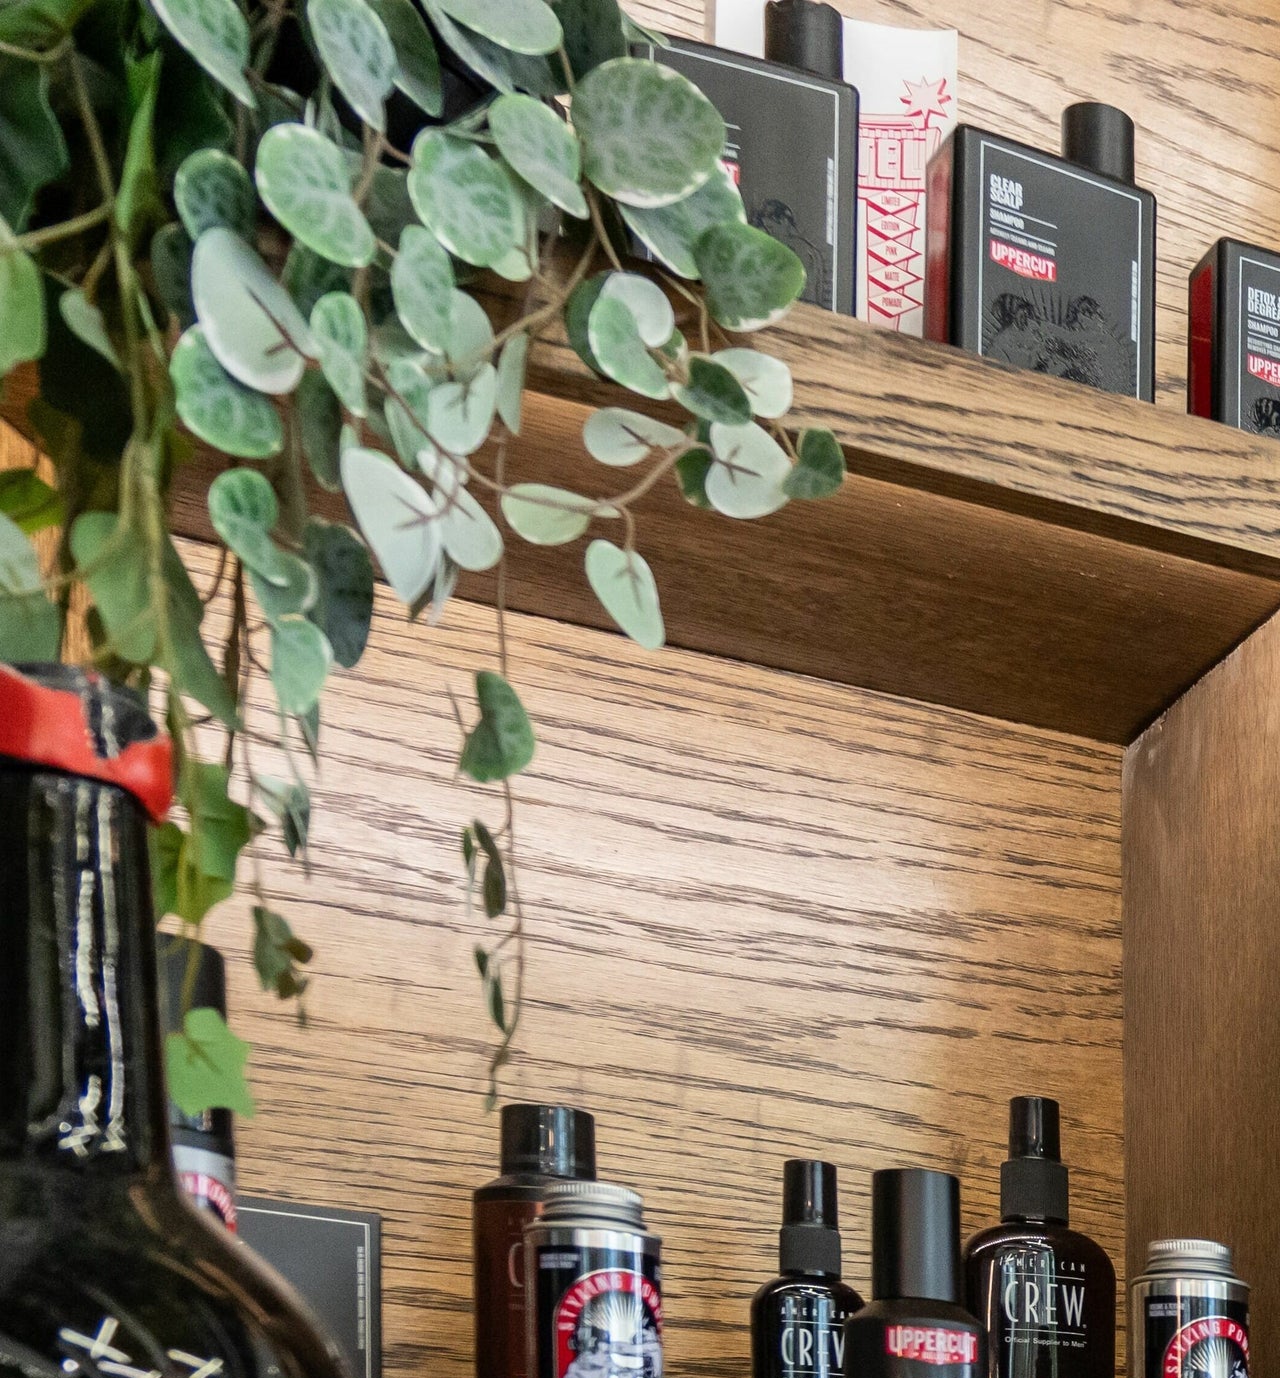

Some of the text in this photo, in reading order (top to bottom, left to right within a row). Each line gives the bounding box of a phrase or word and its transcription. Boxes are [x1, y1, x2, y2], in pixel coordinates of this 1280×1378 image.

[990, 174, 1023, 198] CLEAR
[882, 196, 900, 207] LIMITED
[990, 186, 1023, 210] SCALP
[881, 220, 900, 231] EDITION
[990, 208, 1025, 230] SHAMPOO
[885, 246, 897, 256] PINK
[991, 241, 1055, 280] UPPERCUT
[884, 271, 900, 282] MATTE
[882, 296, 902, 307] POMADE
[1248, 286, 1277, 308] DETOX
[1248, 320, 1278, 337] SHAMPOO
[1004, 1280, 1085, 1327] CREW
[889, 1328, 977, 1361] UPPERCUT
[1004, 1336, 1029, 1344] Official
[1032, 1337, 1061, 1346] Supplier
[1166, 1319, 1221, 1375] STYLING
